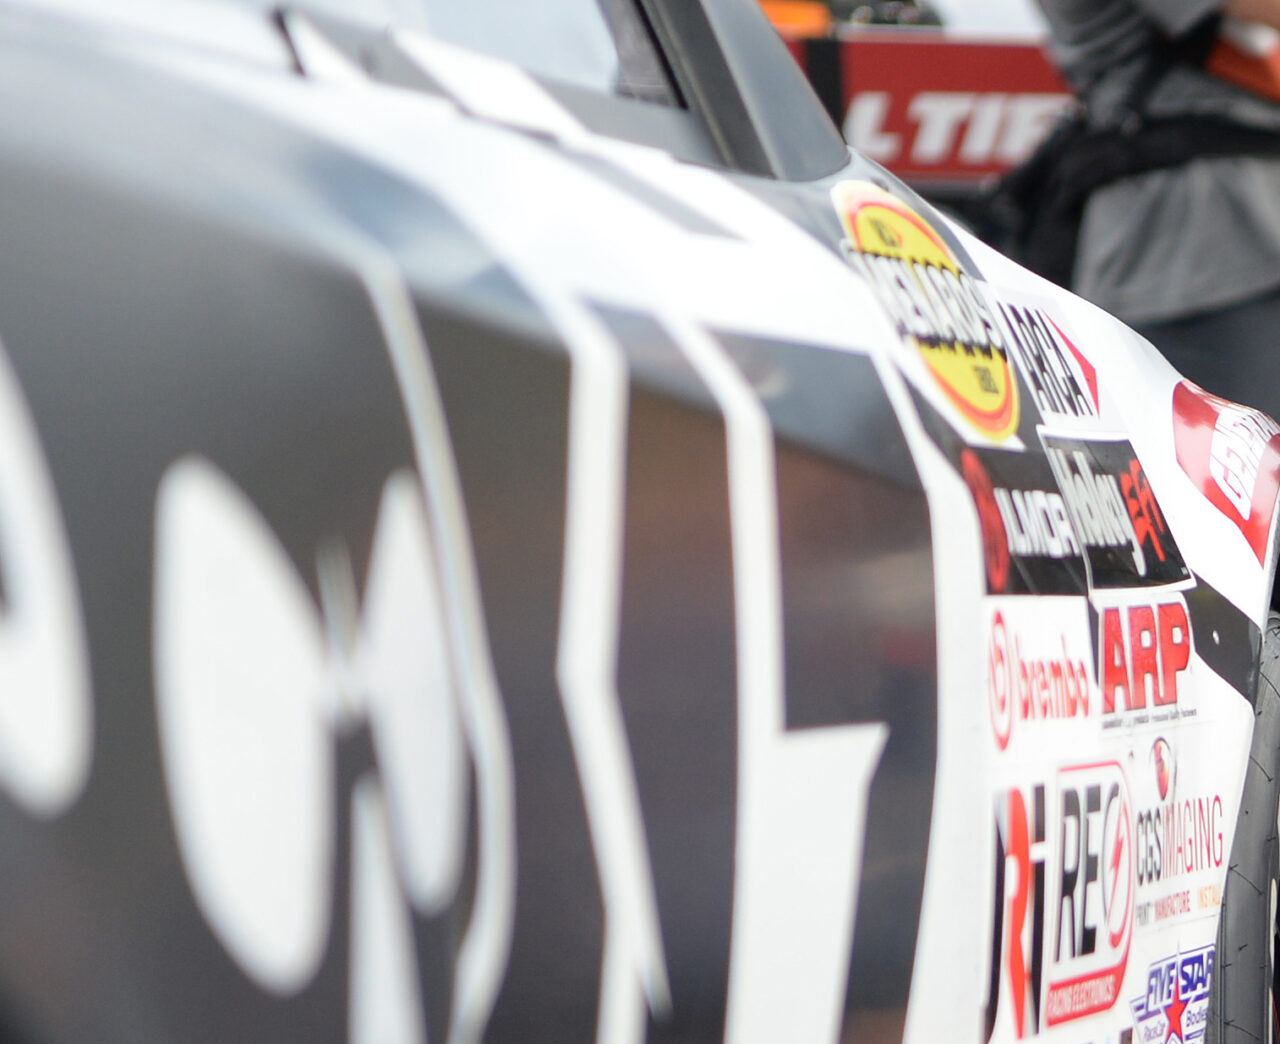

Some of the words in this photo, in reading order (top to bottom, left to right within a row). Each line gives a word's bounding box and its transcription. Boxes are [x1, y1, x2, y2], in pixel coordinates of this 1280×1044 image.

[996, 300, 1097, 417] ARCA
[1015, 634, 1090, 721] brembo
[1101, 602, 1191, 714] ARP
